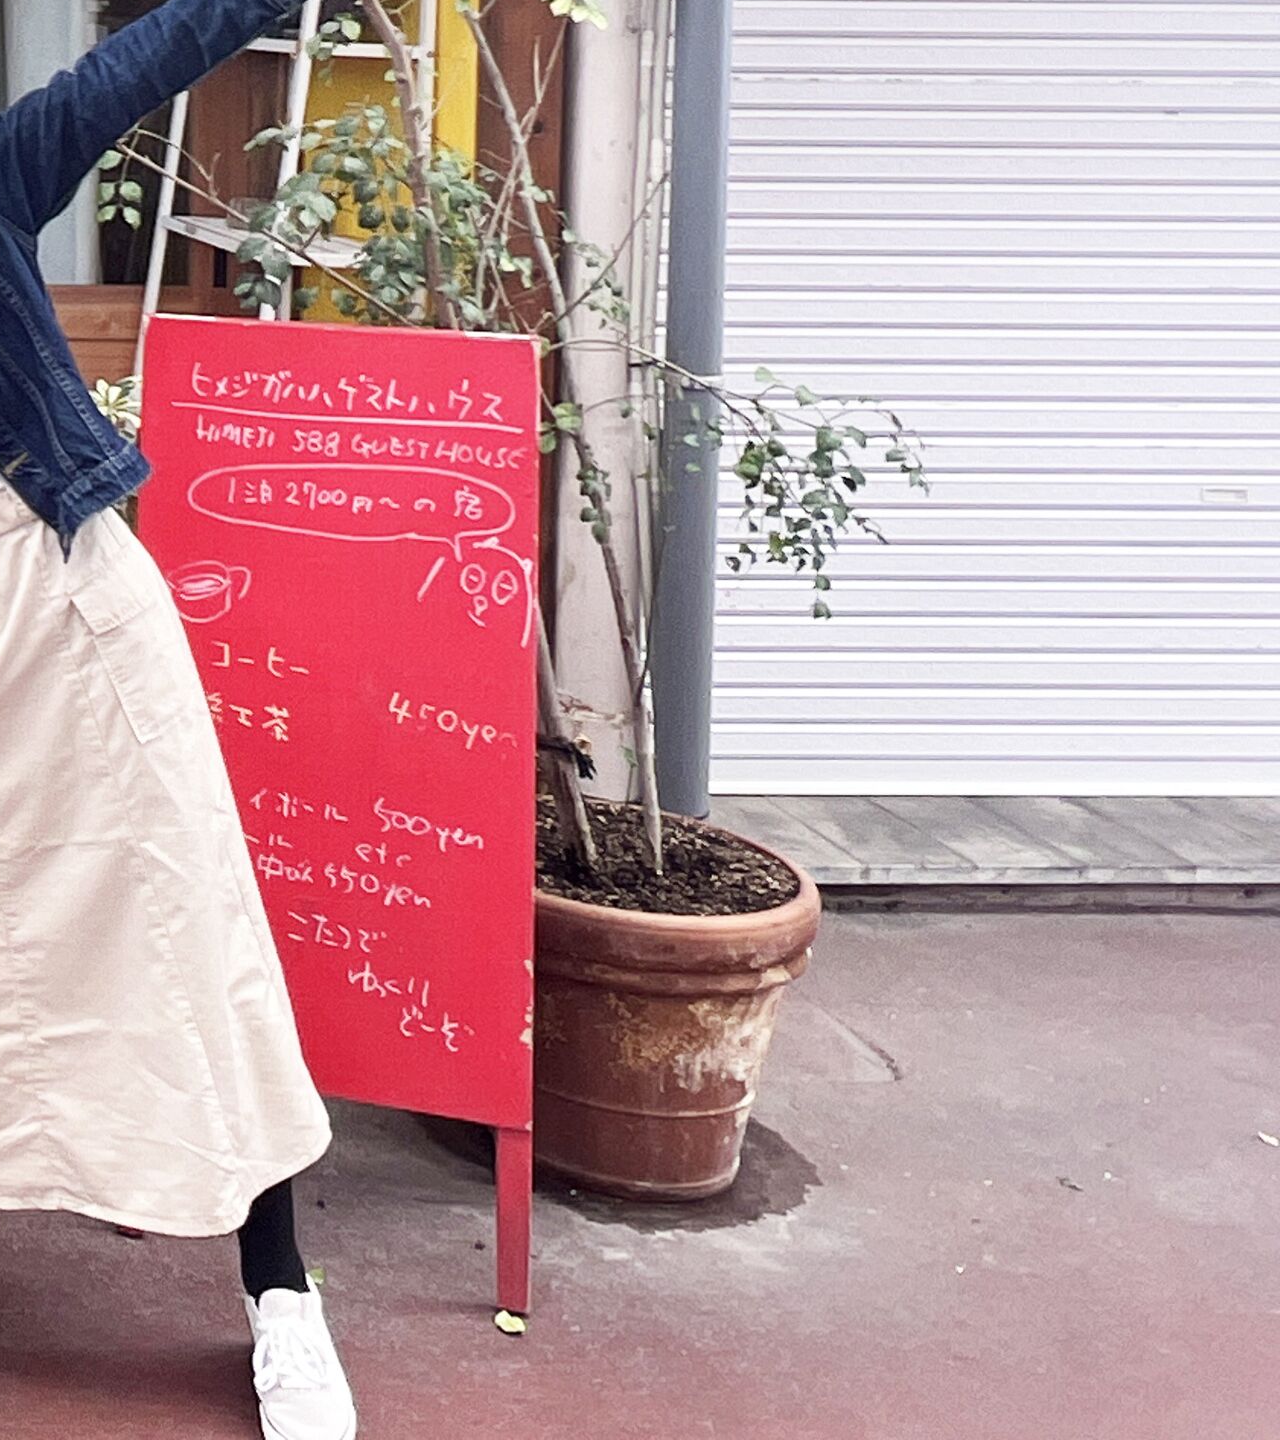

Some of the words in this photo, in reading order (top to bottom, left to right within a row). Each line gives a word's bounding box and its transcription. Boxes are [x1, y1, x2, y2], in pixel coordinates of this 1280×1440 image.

[196, 413, 276, 449] HIMEJI
[292, 430, 340, 458] 588
[210, 640, 310, 678] コーヒー
[249, 788, 348, 822] イボール
[243, 831, 293, 848] ール
[288, 911, 388, 953] こたつで
